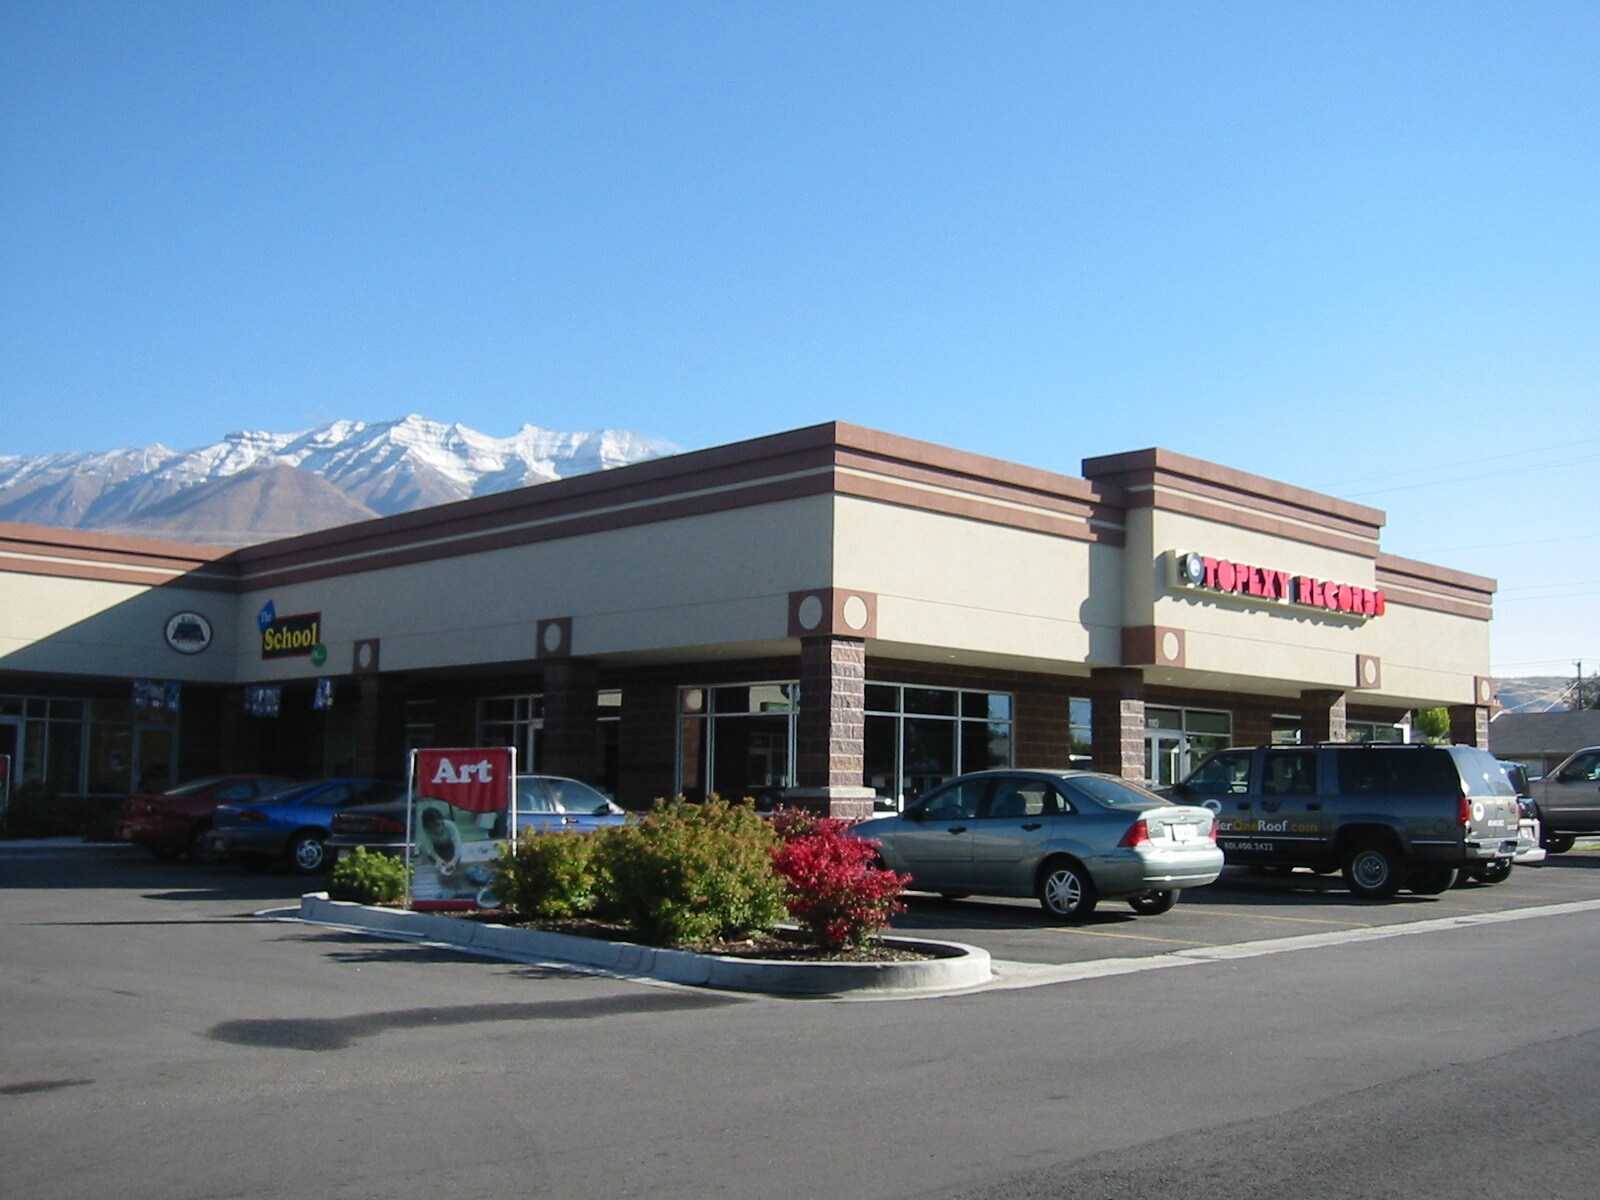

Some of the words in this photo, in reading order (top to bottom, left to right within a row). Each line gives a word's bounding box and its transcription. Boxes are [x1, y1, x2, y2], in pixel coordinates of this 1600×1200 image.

[1203, 556, 1291, 599] TOPEXY
[1298, 575, 1386, 617] RECORDS
[264, 622, 317, 651] School
[431, 757, 493, 784] Art
